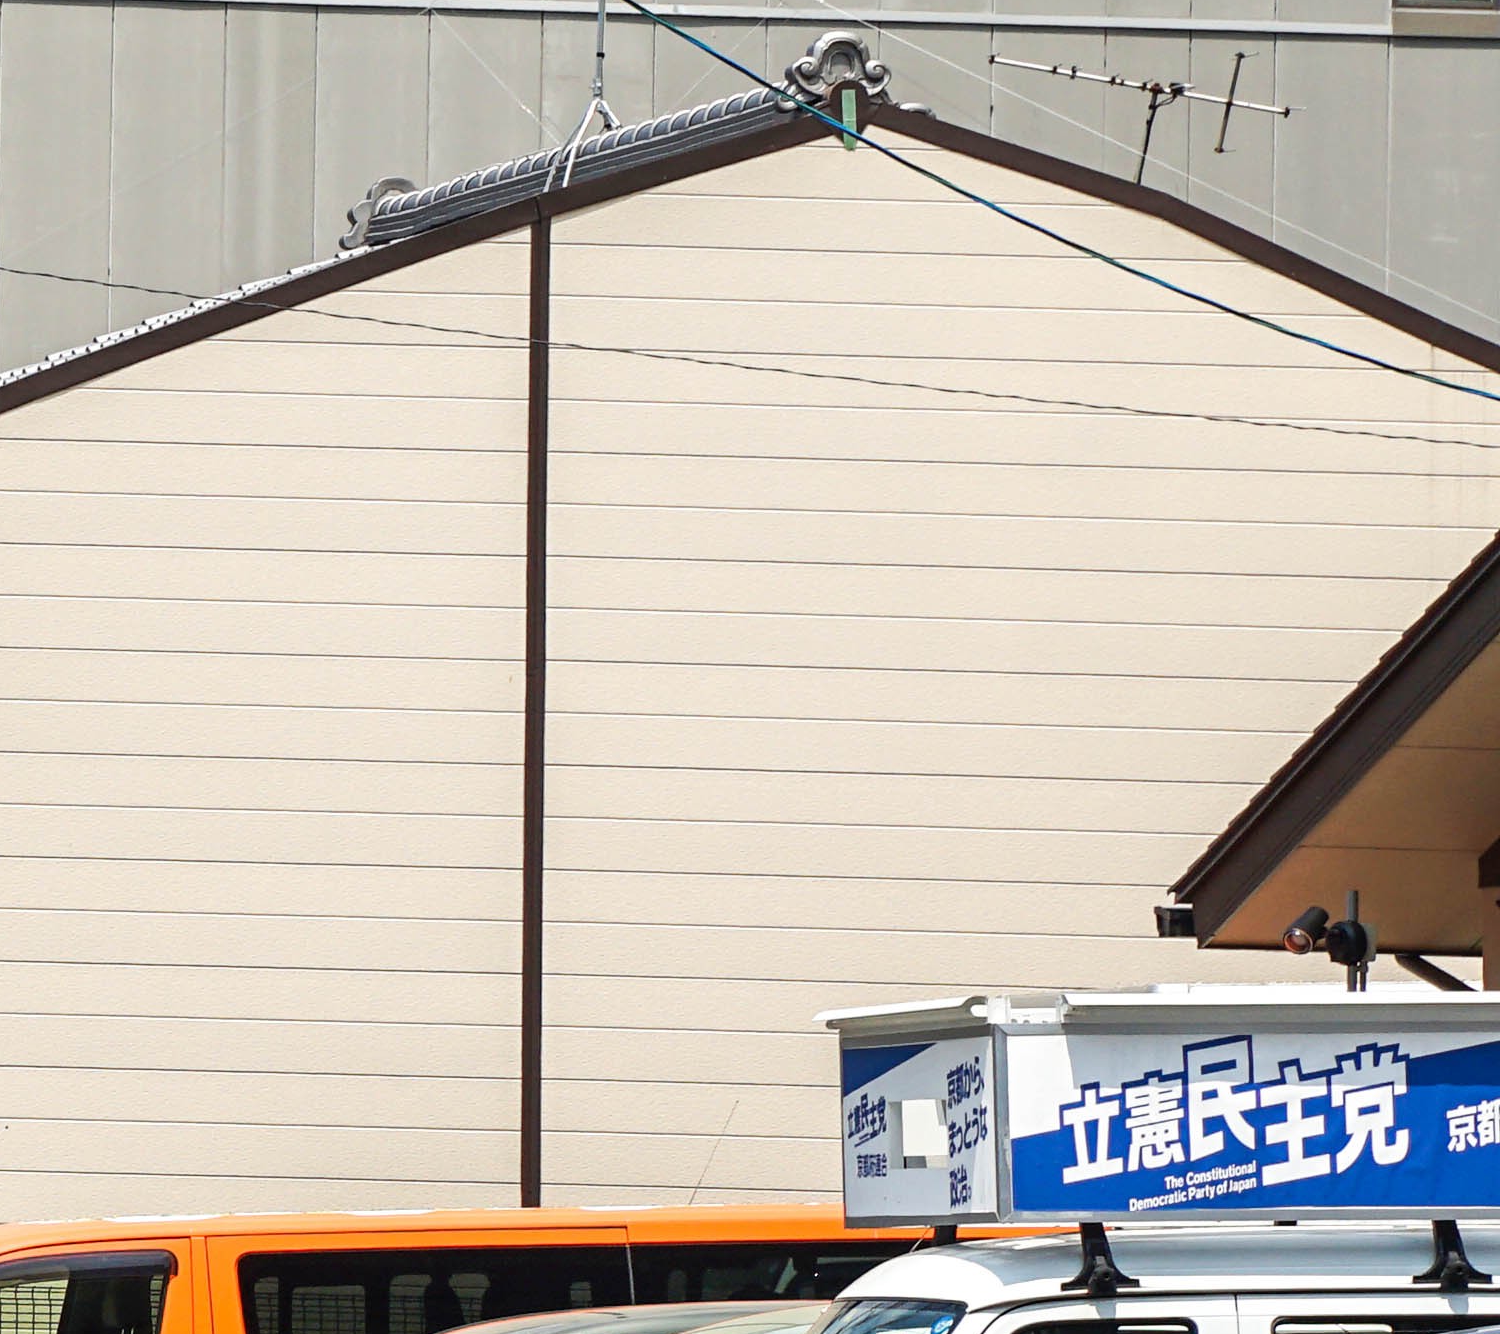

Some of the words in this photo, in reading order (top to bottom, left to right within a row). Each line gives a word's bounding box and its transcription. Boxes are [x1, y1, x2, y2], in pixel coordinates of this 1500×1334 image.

[949, 1105, 988, 1158] まっとうな
[1060, 1034, 1412, 1187] 立憲民主党
[1128, 1189, 1188, 1212] Democratic
[1187, 1184, 1216, 1203] Party
[1216, 1181, 1229, 1196] of
[1228, 1176, 1257, 1194] Japan
[1164, 1175, 1185, 1190] The
[1186, 1160, 1257, 1187] Constitutional
